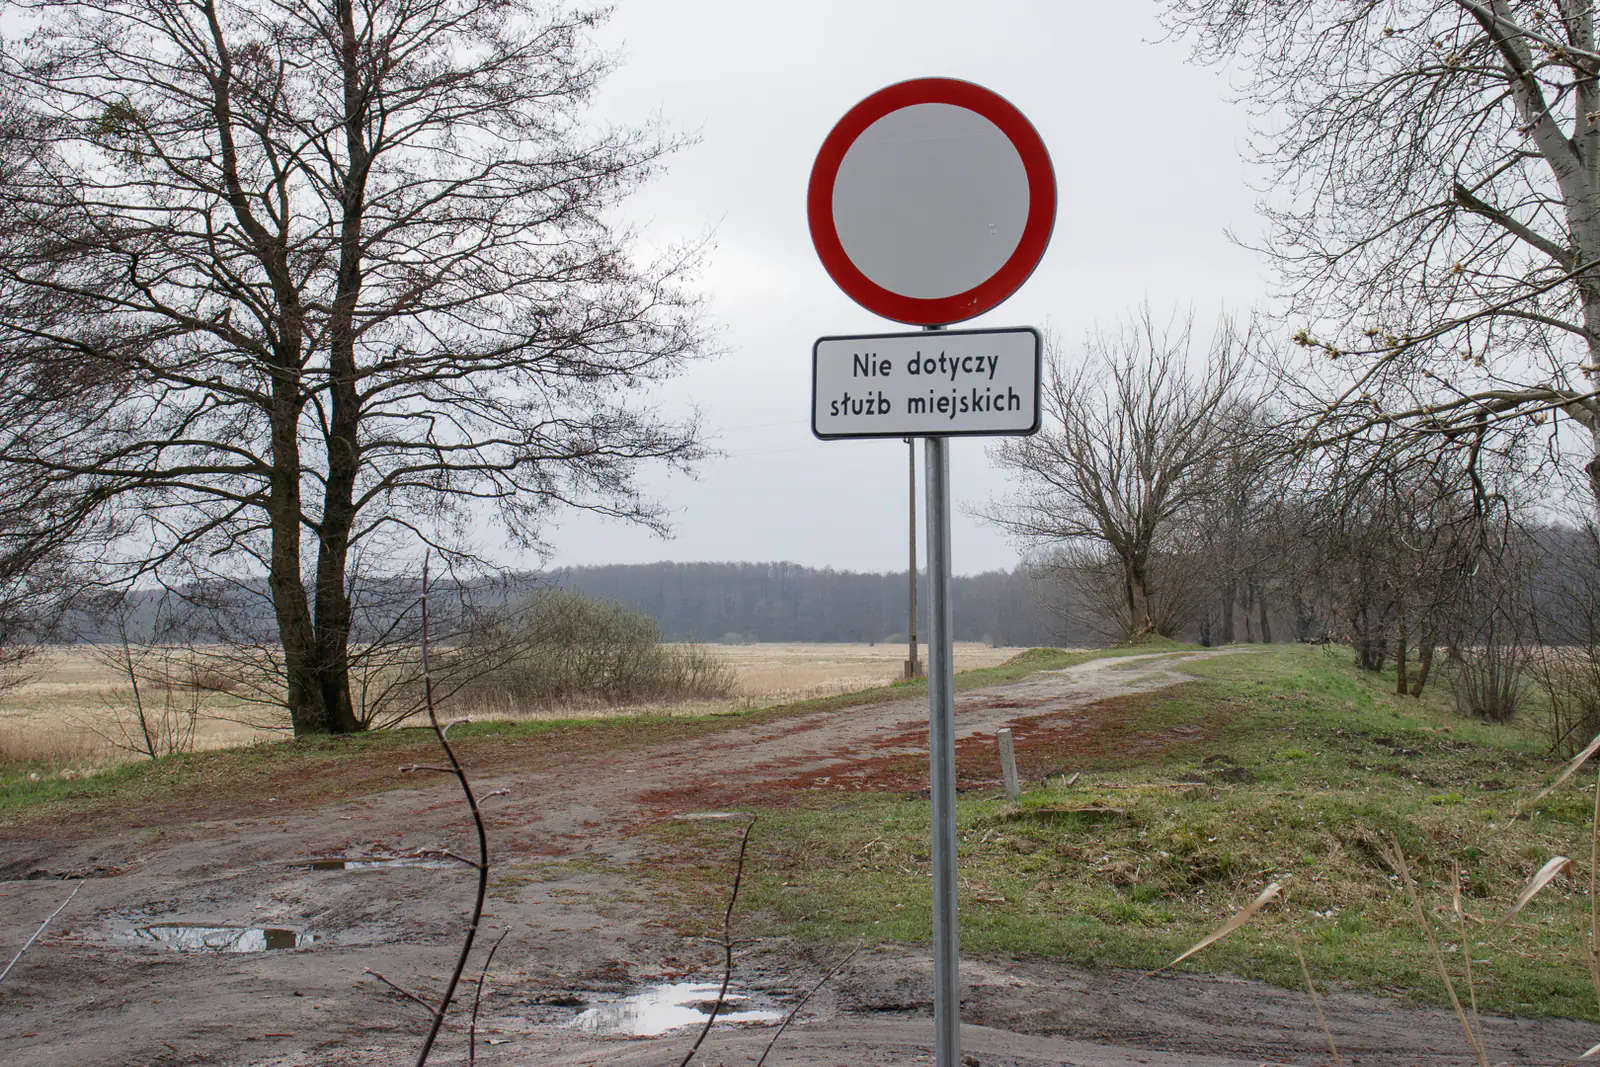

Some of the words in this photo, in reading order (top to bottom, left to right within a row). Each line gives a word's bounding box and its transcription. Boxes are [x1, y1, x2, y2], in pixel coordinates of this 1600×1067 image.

[853, 352, 892, 377] Nie
[907, 350, 999, 381] dotyczy
[830, 391, 892, 416] służb
[907, 386, 1021, 419] miejskich
